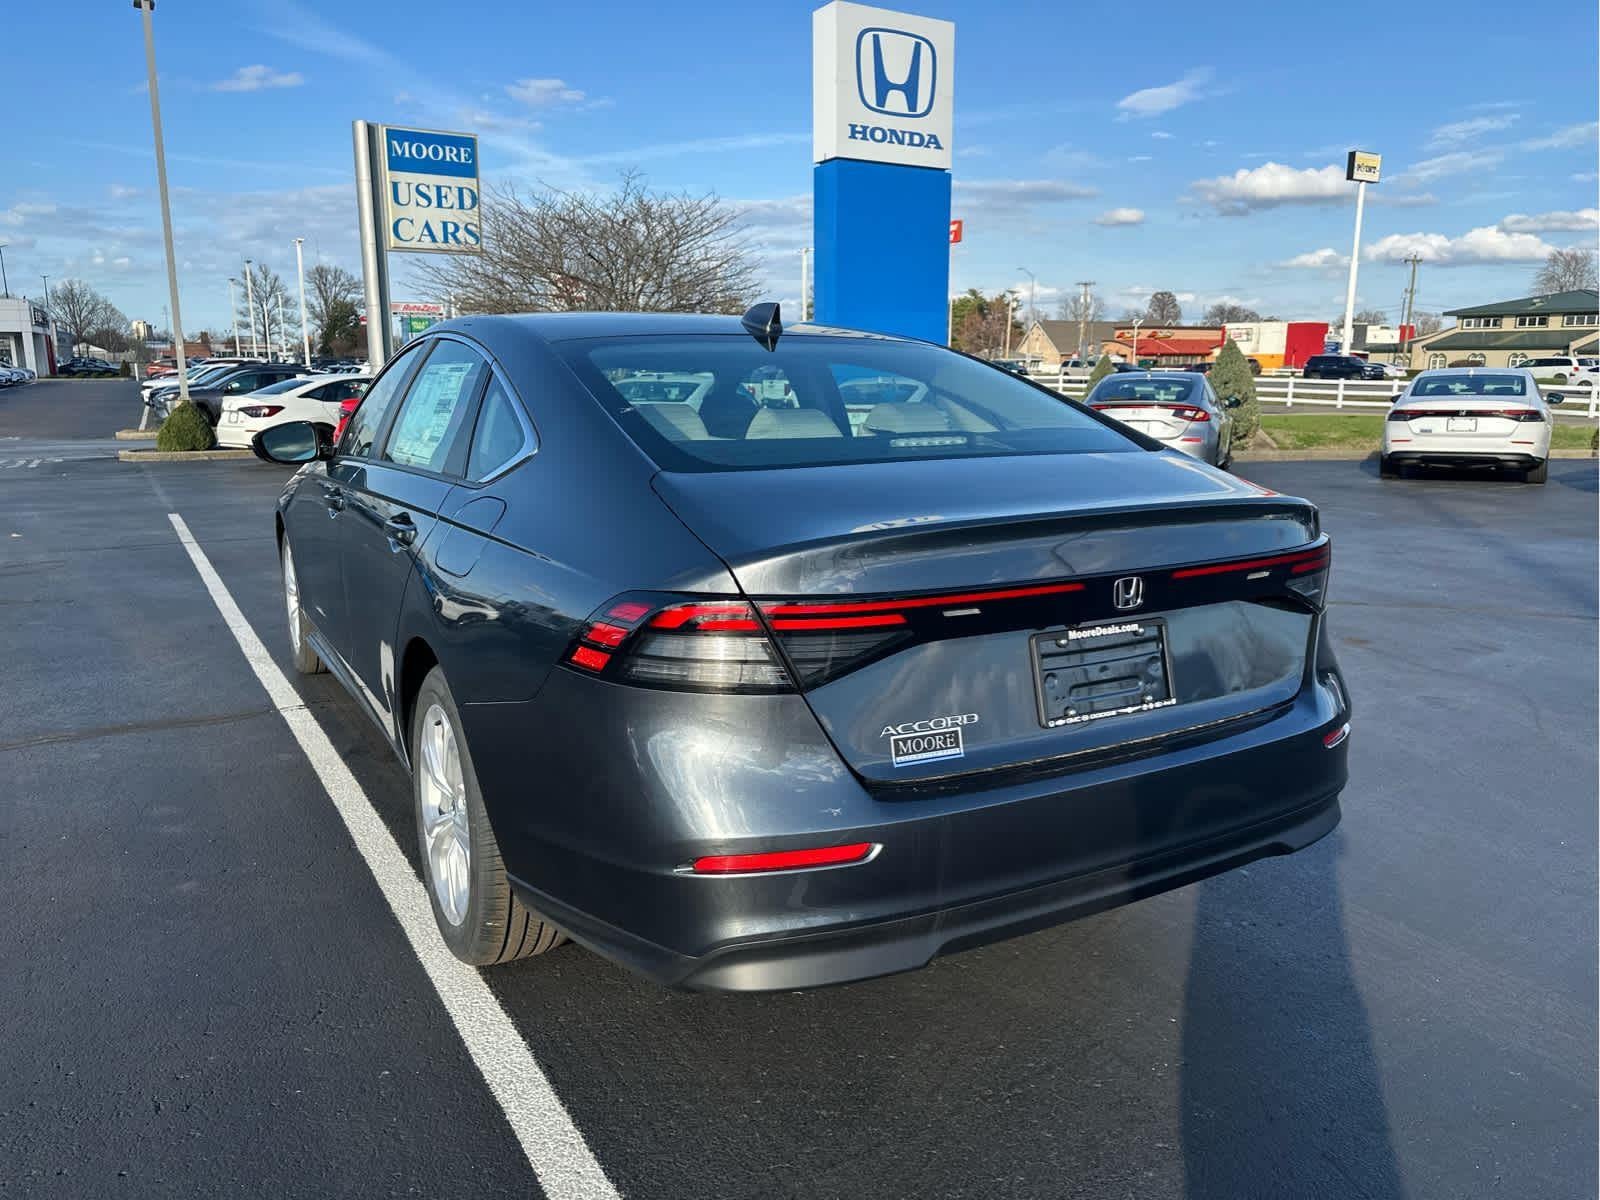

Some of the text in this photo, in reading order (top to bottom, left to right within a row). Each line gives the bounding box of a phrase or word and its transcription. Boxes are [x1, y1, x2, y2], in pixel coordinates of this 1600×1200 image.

[848, 123, 944, 150] HONDA
[391, 140, 472, 164] MOORE
[391, 181, 478, 210] USED
[392, 217, 480, 245] CARS
[1068, 624, 1139, 640] MooreDeals.com
[880, 713, 979, 738] ACCORD
[898, 733, 956, 755] MOORE
